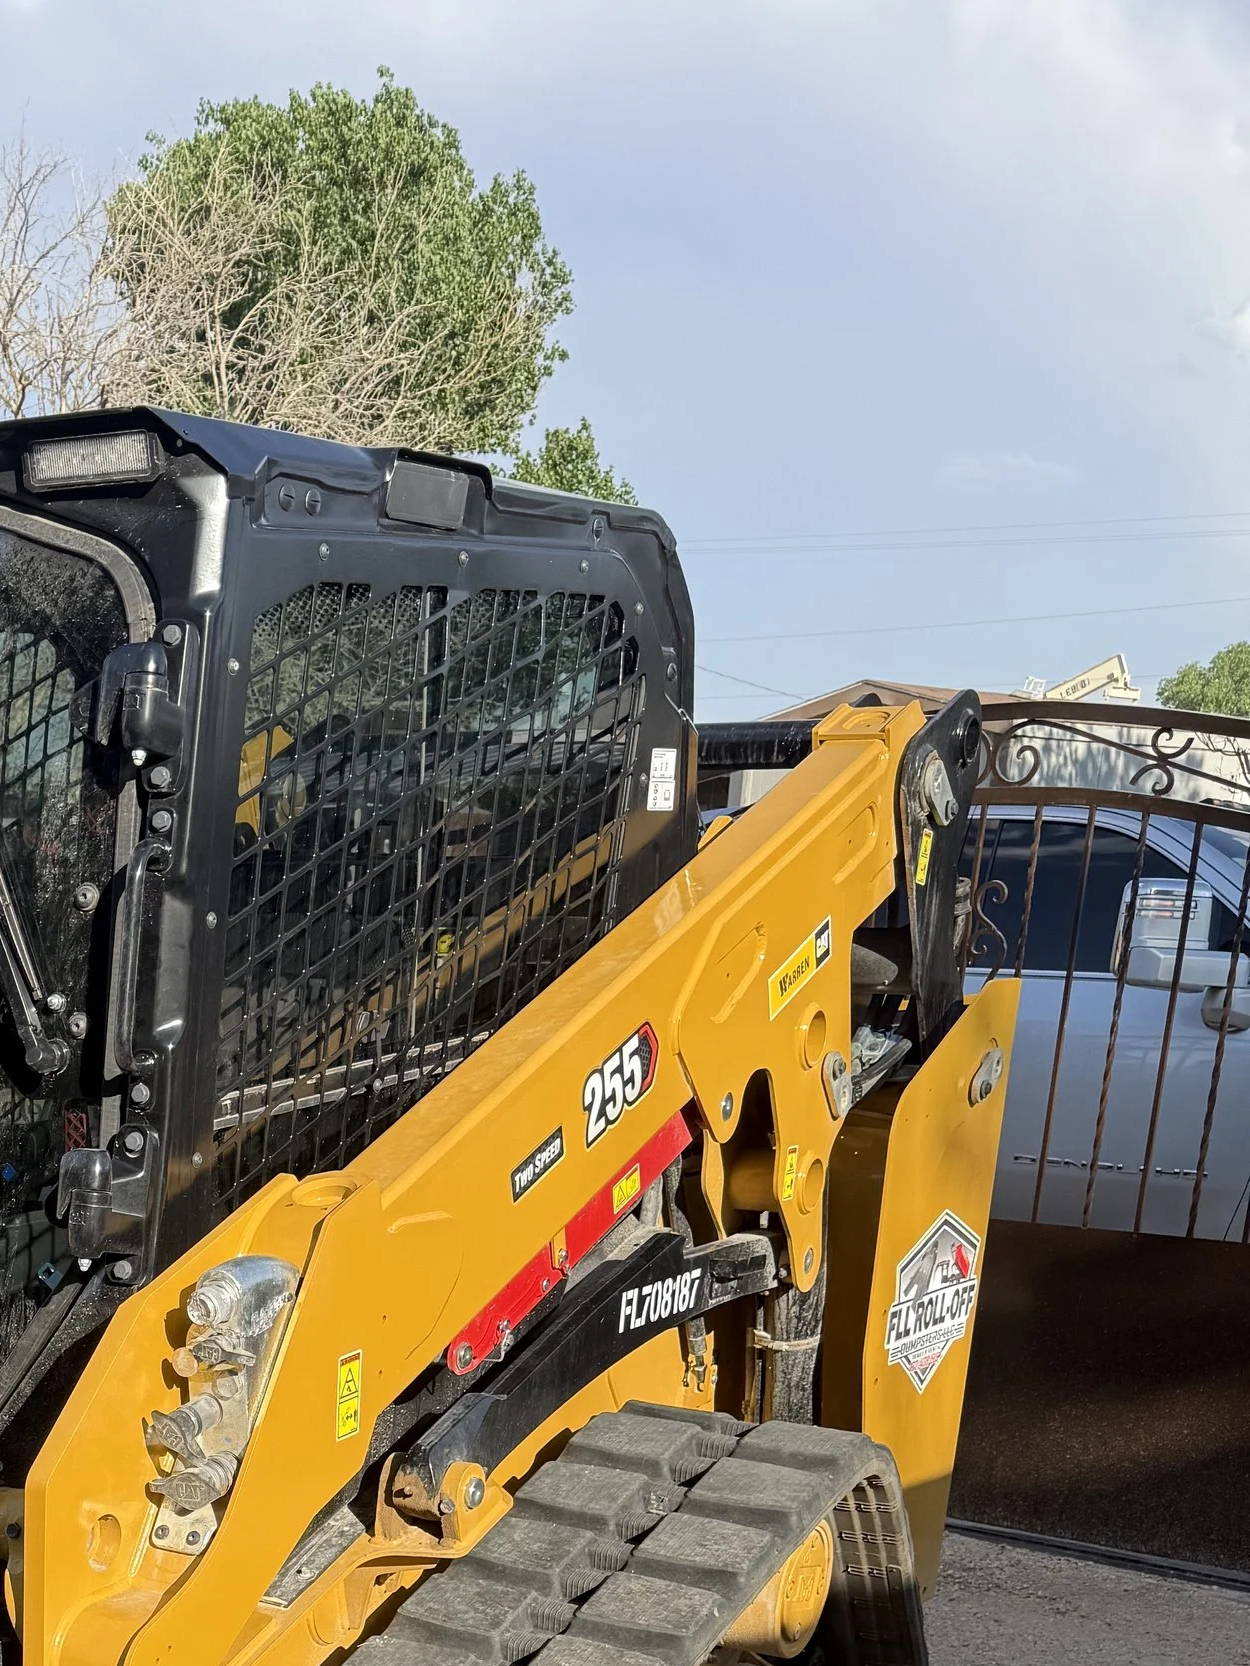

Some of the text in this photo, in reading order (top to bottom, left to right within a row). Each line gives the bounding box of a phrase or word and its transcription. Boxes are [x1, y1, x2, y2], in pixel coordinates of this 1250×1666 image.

[779, 955, 810, 997] WARREN
[583, 1033, 642, 1144] 255
[618, 1268, 702, 1334] FL708187
[887, 1284, 976, 1345] FLL ROLL-OFF
